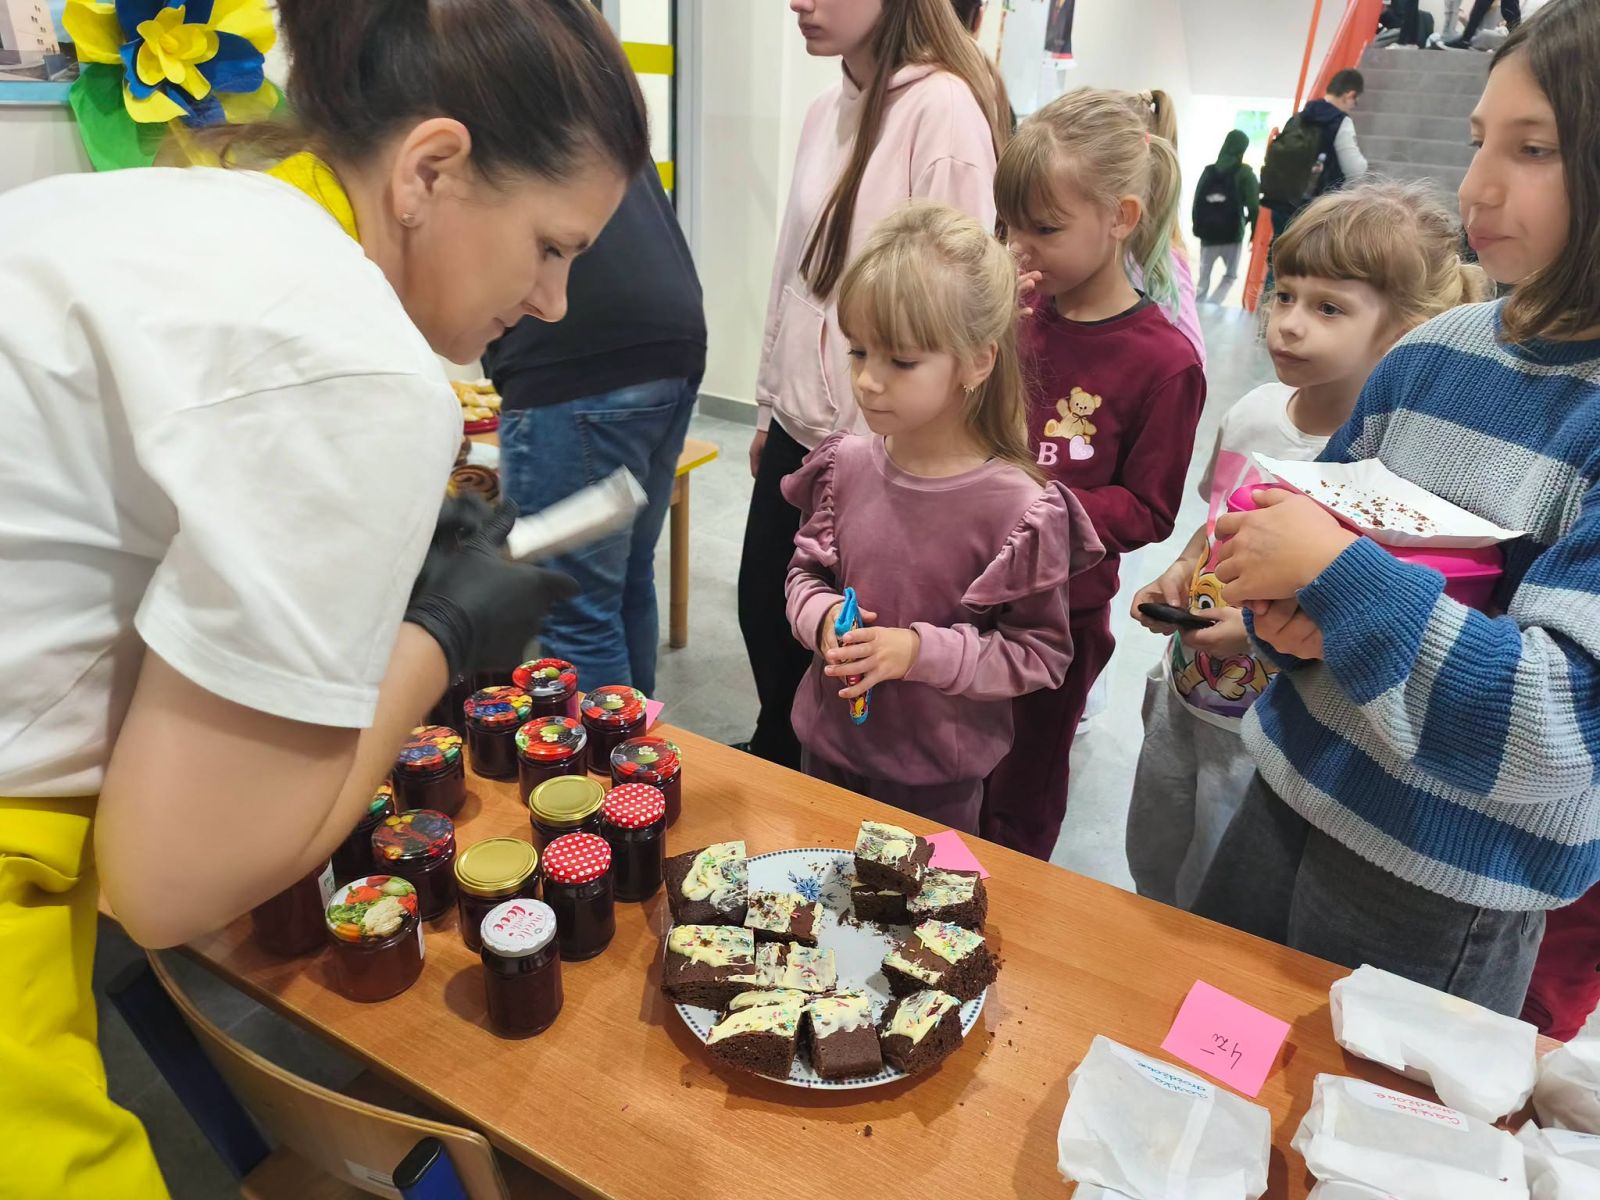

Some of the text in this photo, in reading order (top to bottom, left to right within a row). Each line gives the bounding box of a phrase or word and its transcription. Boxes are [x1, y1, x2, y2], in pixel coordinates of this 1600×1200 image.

[1036, 441, 1058, 466] B
[493, 905, 526, 933] love
[1230, 1042, 1242, 1070] 4
